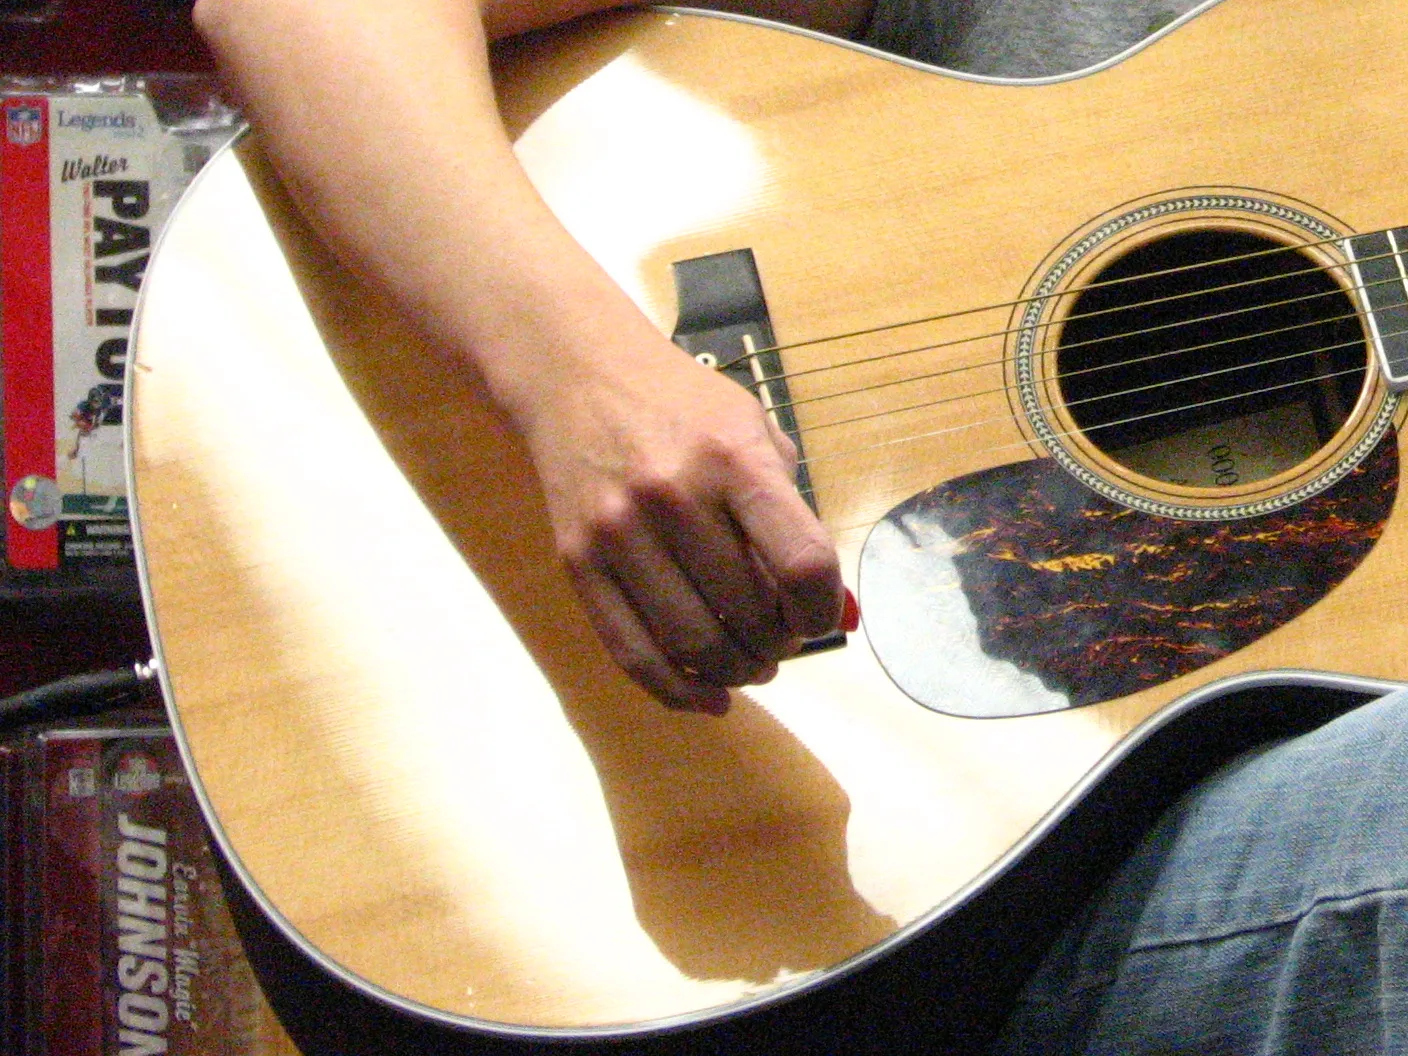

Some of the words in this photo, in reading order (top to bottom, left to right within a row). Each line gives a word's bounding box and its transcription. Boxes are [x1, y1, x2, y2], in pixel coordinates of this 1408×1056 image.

[57, 110, 137, 131] Legends
[61, 154, 130, 183] Walter
[116, 813, 170, 1056] JOHNSON
